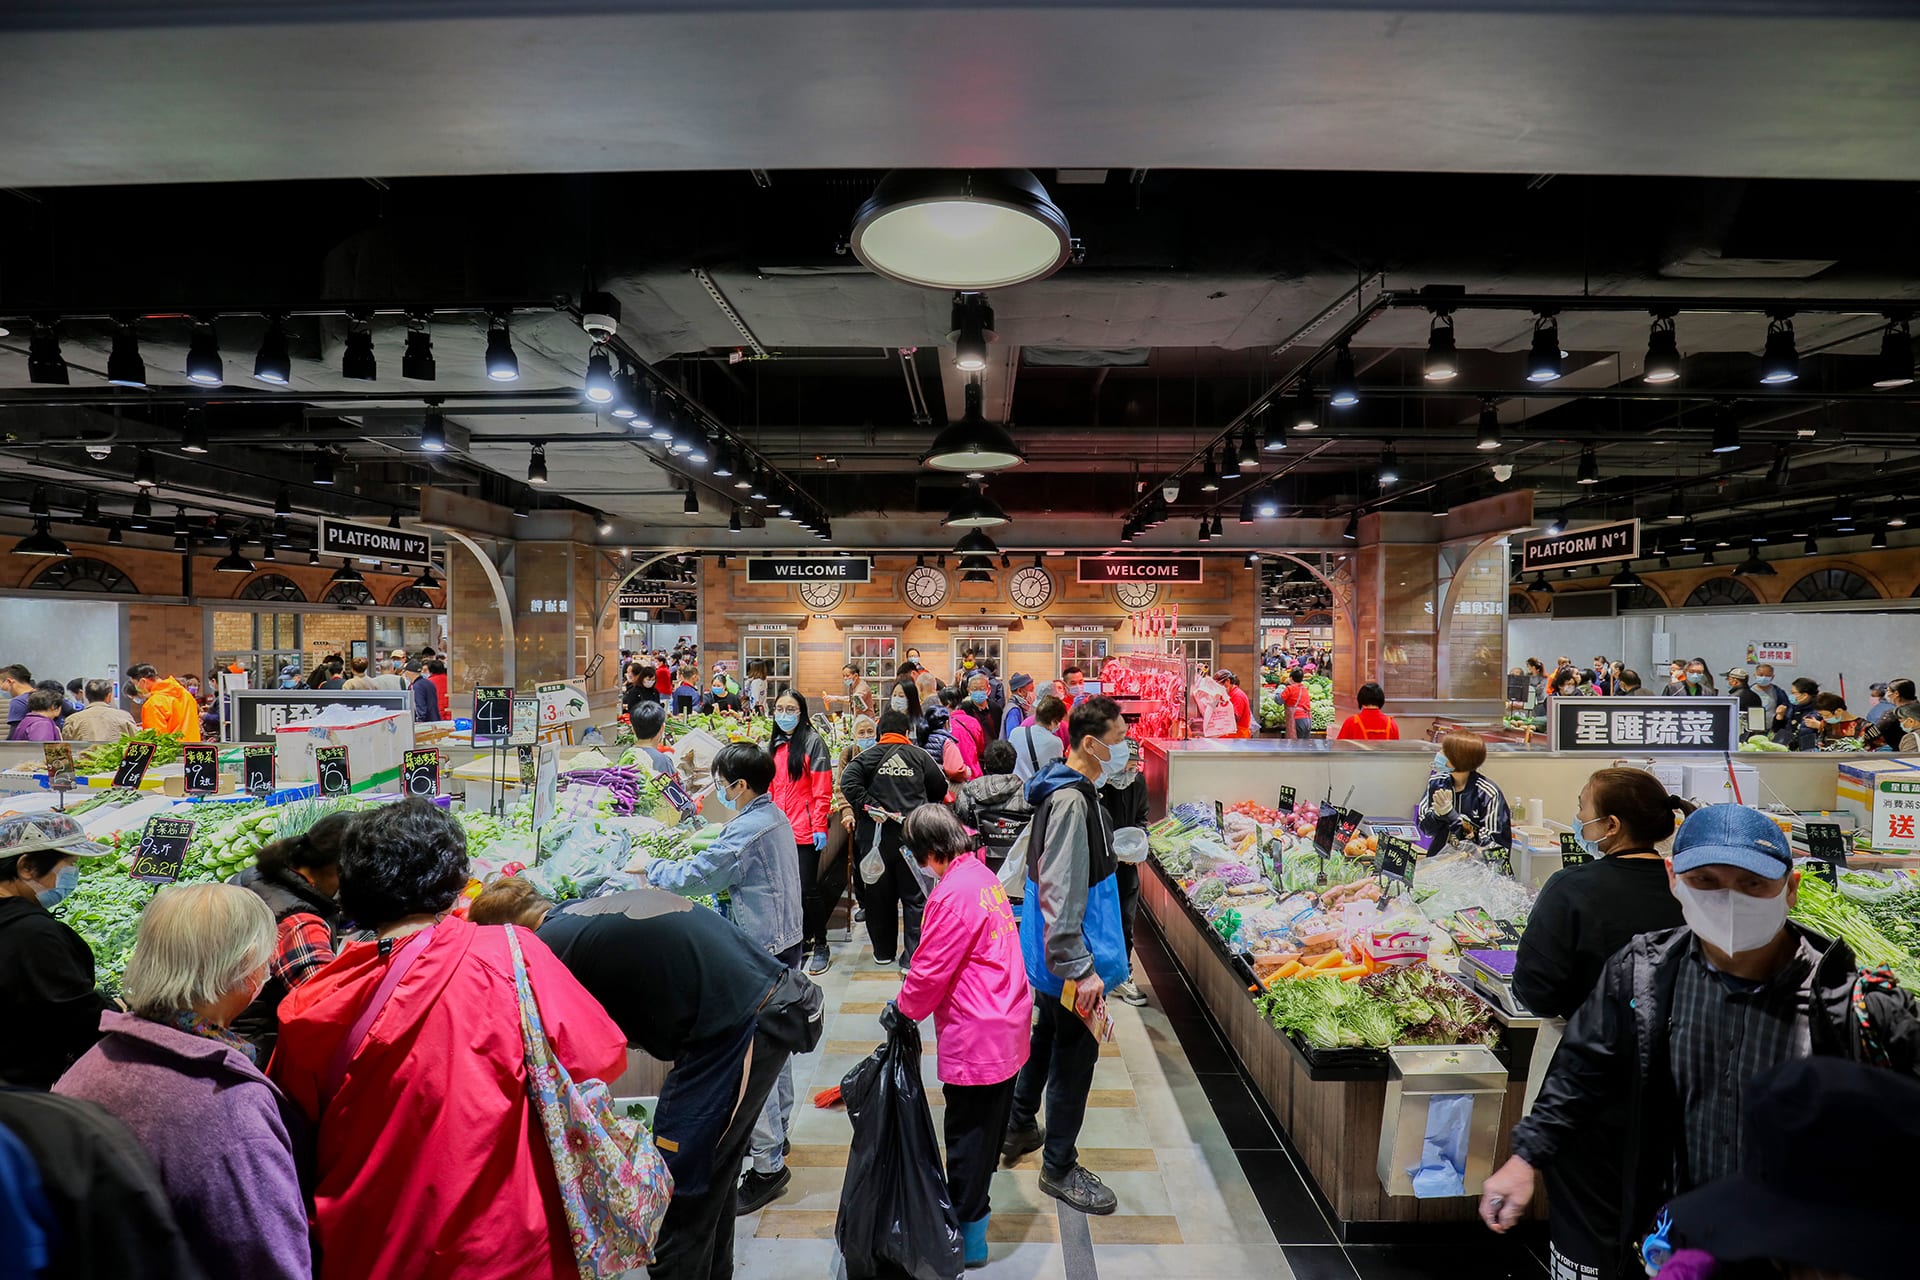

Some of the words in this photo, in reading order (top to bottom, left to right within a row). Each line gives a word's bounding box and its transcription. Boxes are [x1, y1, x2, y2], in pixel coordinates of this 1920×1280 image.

[328, 527, 401, 551] PLATFORM
[404, 539, 425, 554] N°2
[1529, 536, 1597, 559] PLATFORM
[1602, 531, 1627, 549] N°1
[774, 565, 847, 576] WELCOME
[1106, 565, 1179, 576] WELCOME
[619, 596, 651, 604] ATFORM
[1575, 711, 1714, 745] 星匯蔬菜
[877, 766, 915, 777] adidas
[1889, 813, 1915, 839] 送
[1560, 1255, 1579, 1271] FORTY
[1580, 1264, 1599, 1276] EIGHT
